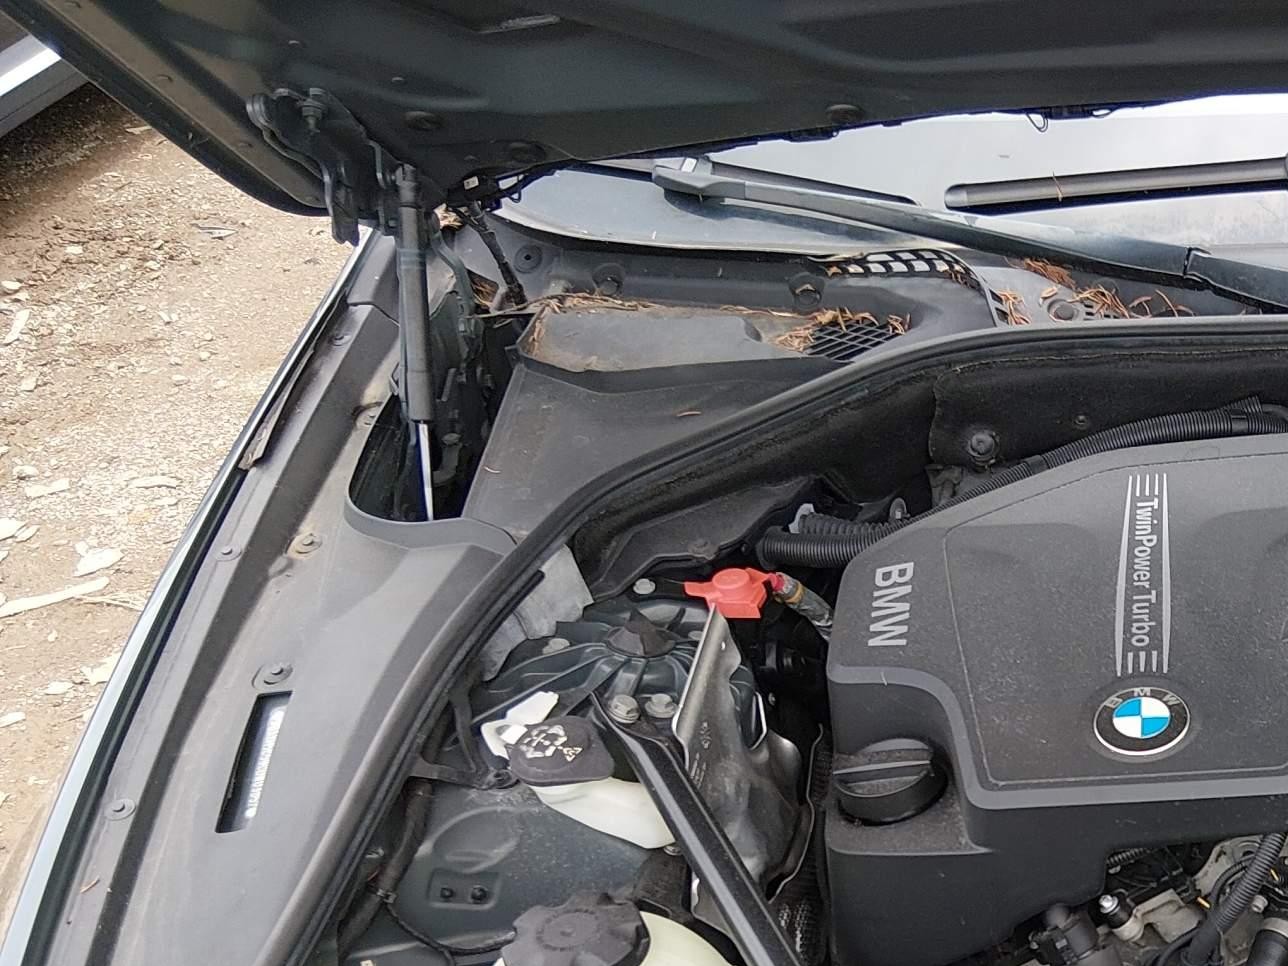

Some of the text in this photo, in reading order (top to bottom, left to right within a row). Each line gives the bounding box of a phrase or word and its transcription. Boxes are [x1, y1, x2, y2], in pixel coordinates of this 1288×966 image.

[866, 561, 914, 647] BMW
[1130, 497, 1158, 647] TwinPower Turbo
[1104, 687, 1181, 709] BMW
